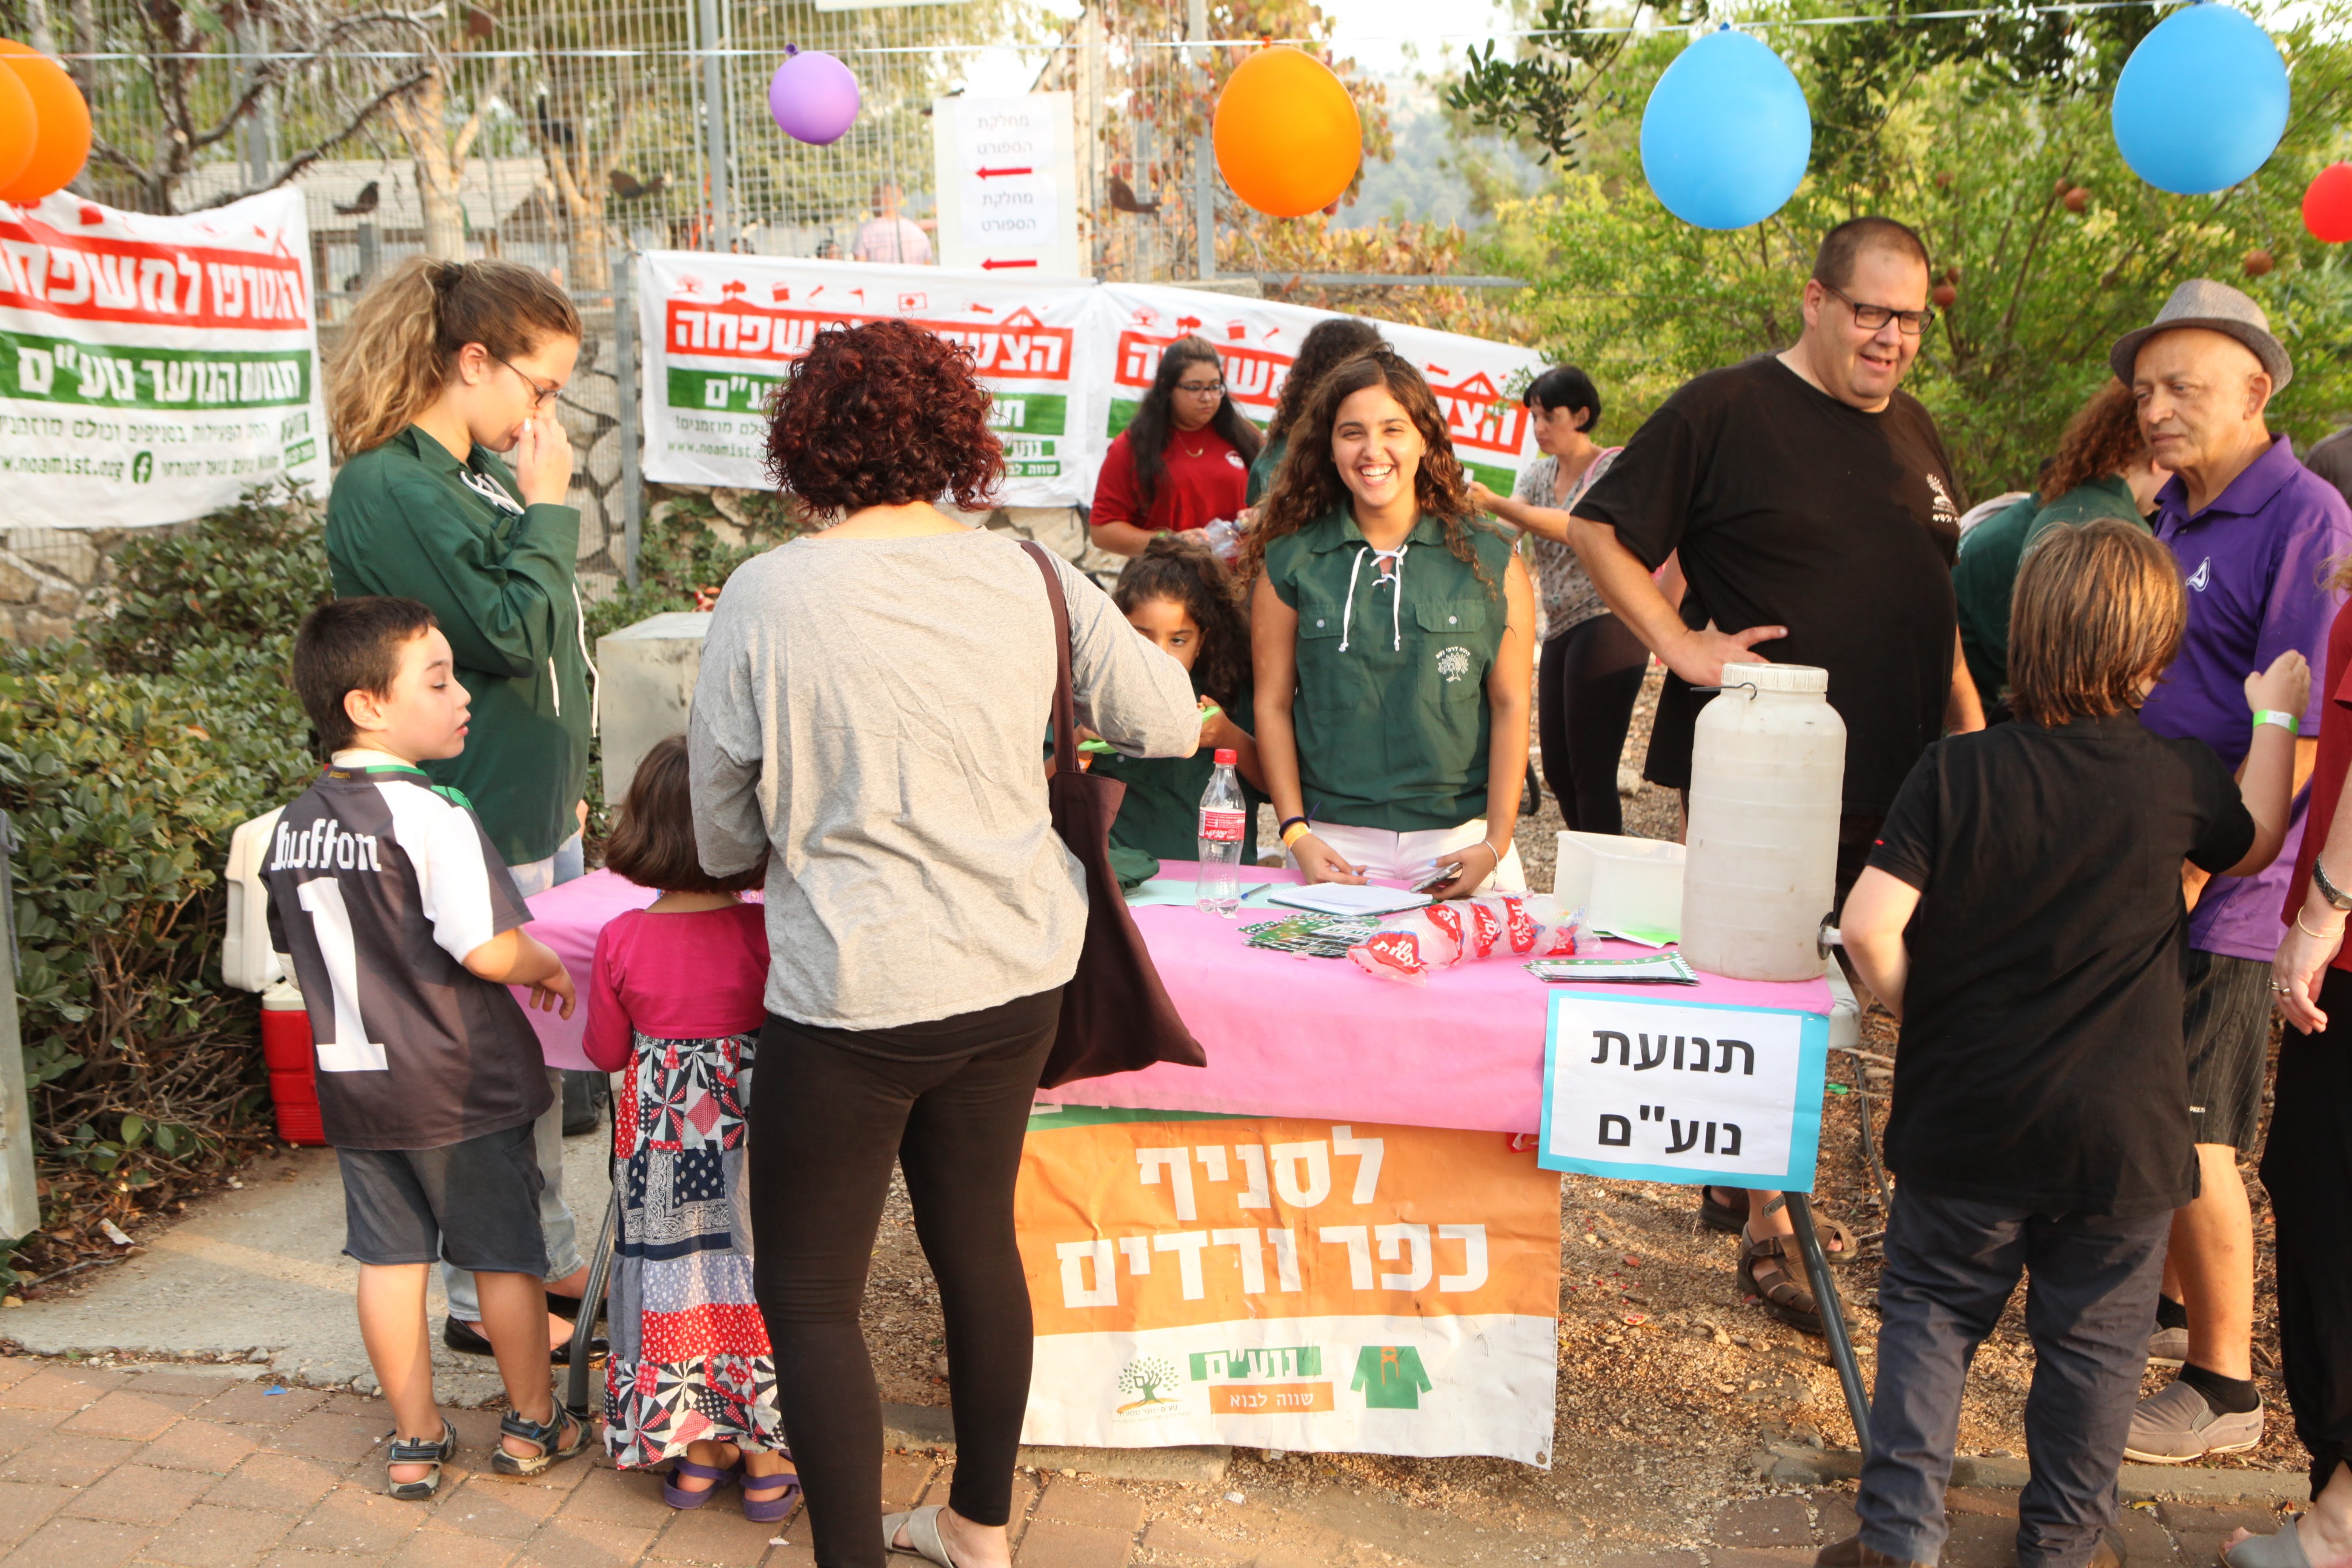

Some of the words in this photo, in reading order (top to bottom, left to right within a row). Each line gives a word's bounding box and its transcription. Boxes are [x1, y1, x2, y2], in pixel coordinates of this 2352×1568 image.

[978, 114, 1030, 131] מחלקת
[982, 190, 1034, 208] מחלקת
[141, 359, 237, 402] הנוער
[1027, 463, 1057, 475] שווה
[297, 877, 389, 1072] 1
[1590, 1030, 1755, 1075] תנועת
[1598, 1105, 1742, 1156] נוע"ם
[1136, 1125, 1384, 1221] לסניף
[1056, 1227, 1302, 1308] ורדים
[1319, 1223, 1488, 1292] כפר
[1230, 1392, 1268, 1407] לבוא
[1276, 1393, 1314, 1406] שווה
